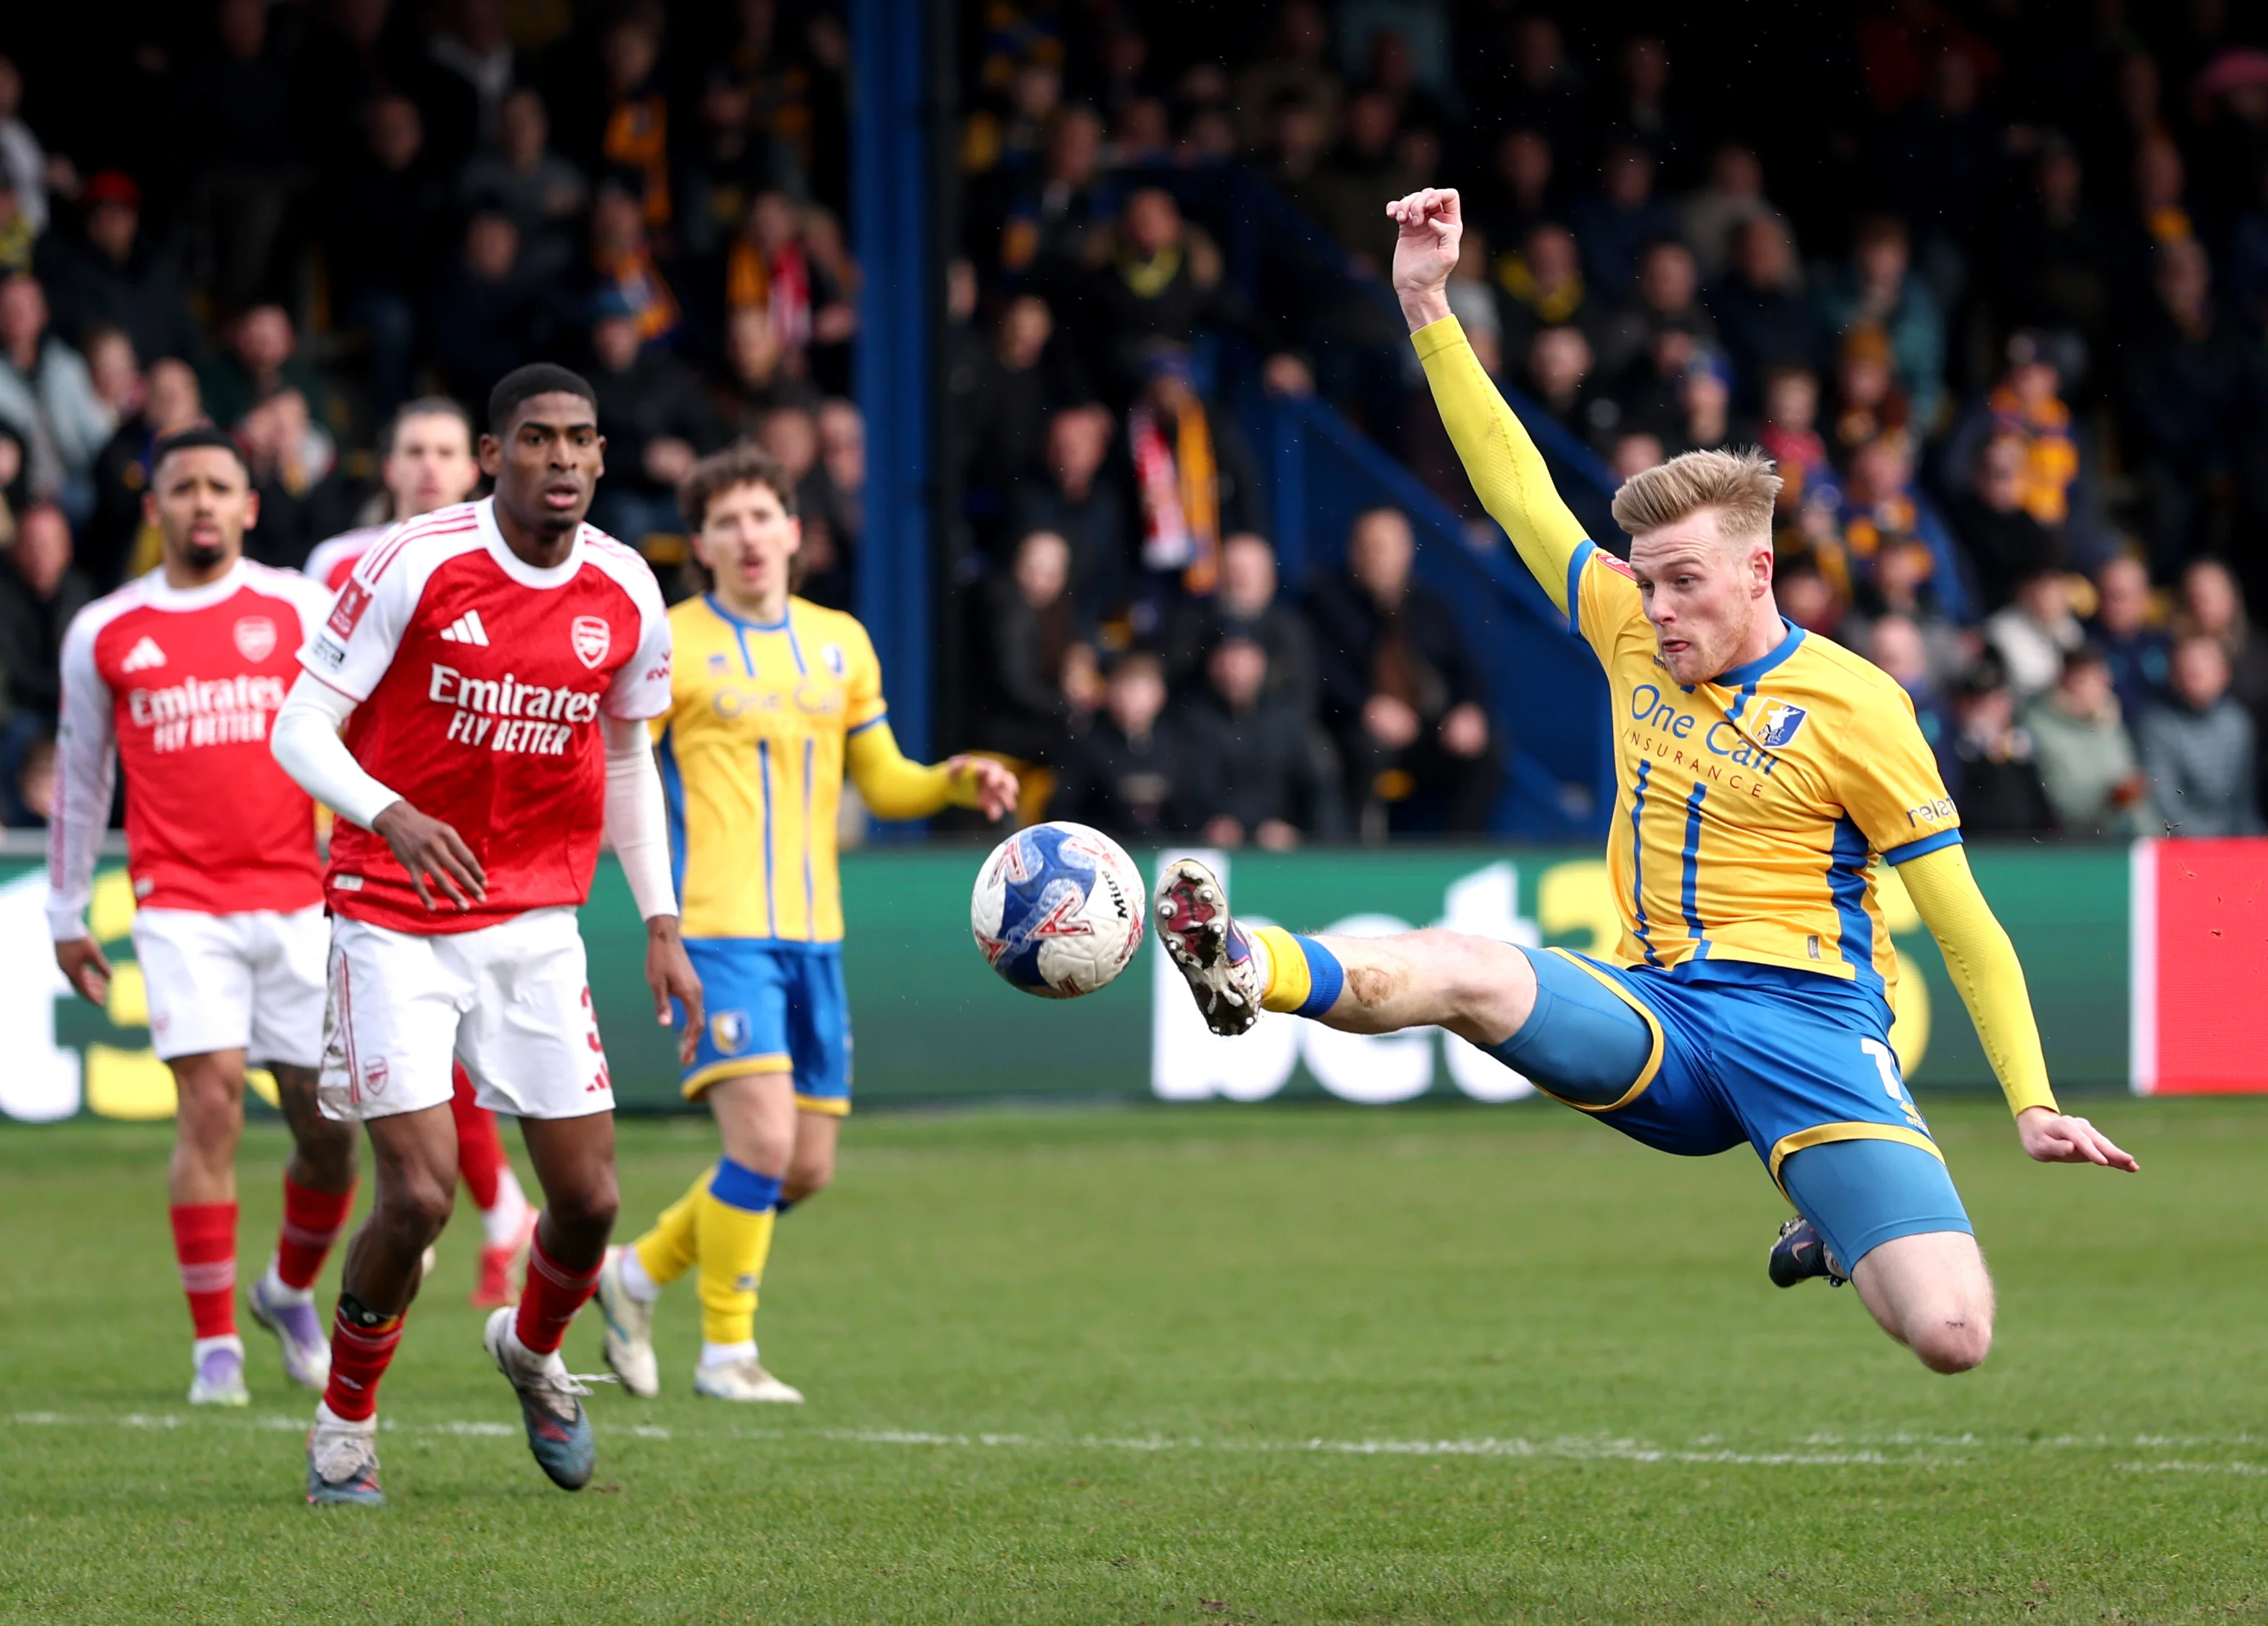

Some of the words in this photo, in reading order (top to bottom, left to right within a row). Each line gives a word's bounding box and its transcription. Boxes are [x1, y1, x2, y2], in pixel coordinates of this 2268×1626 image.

[129, 673, 286, 728] Emirates
[428, 662, 600, 723] Emirates
[1631, 684, 1696, 739] One
[446, 710, 492, 746] FLY
[491, 718, 572, 756] BETTER
[1621, 727, 1764, 798] INSURANCE
